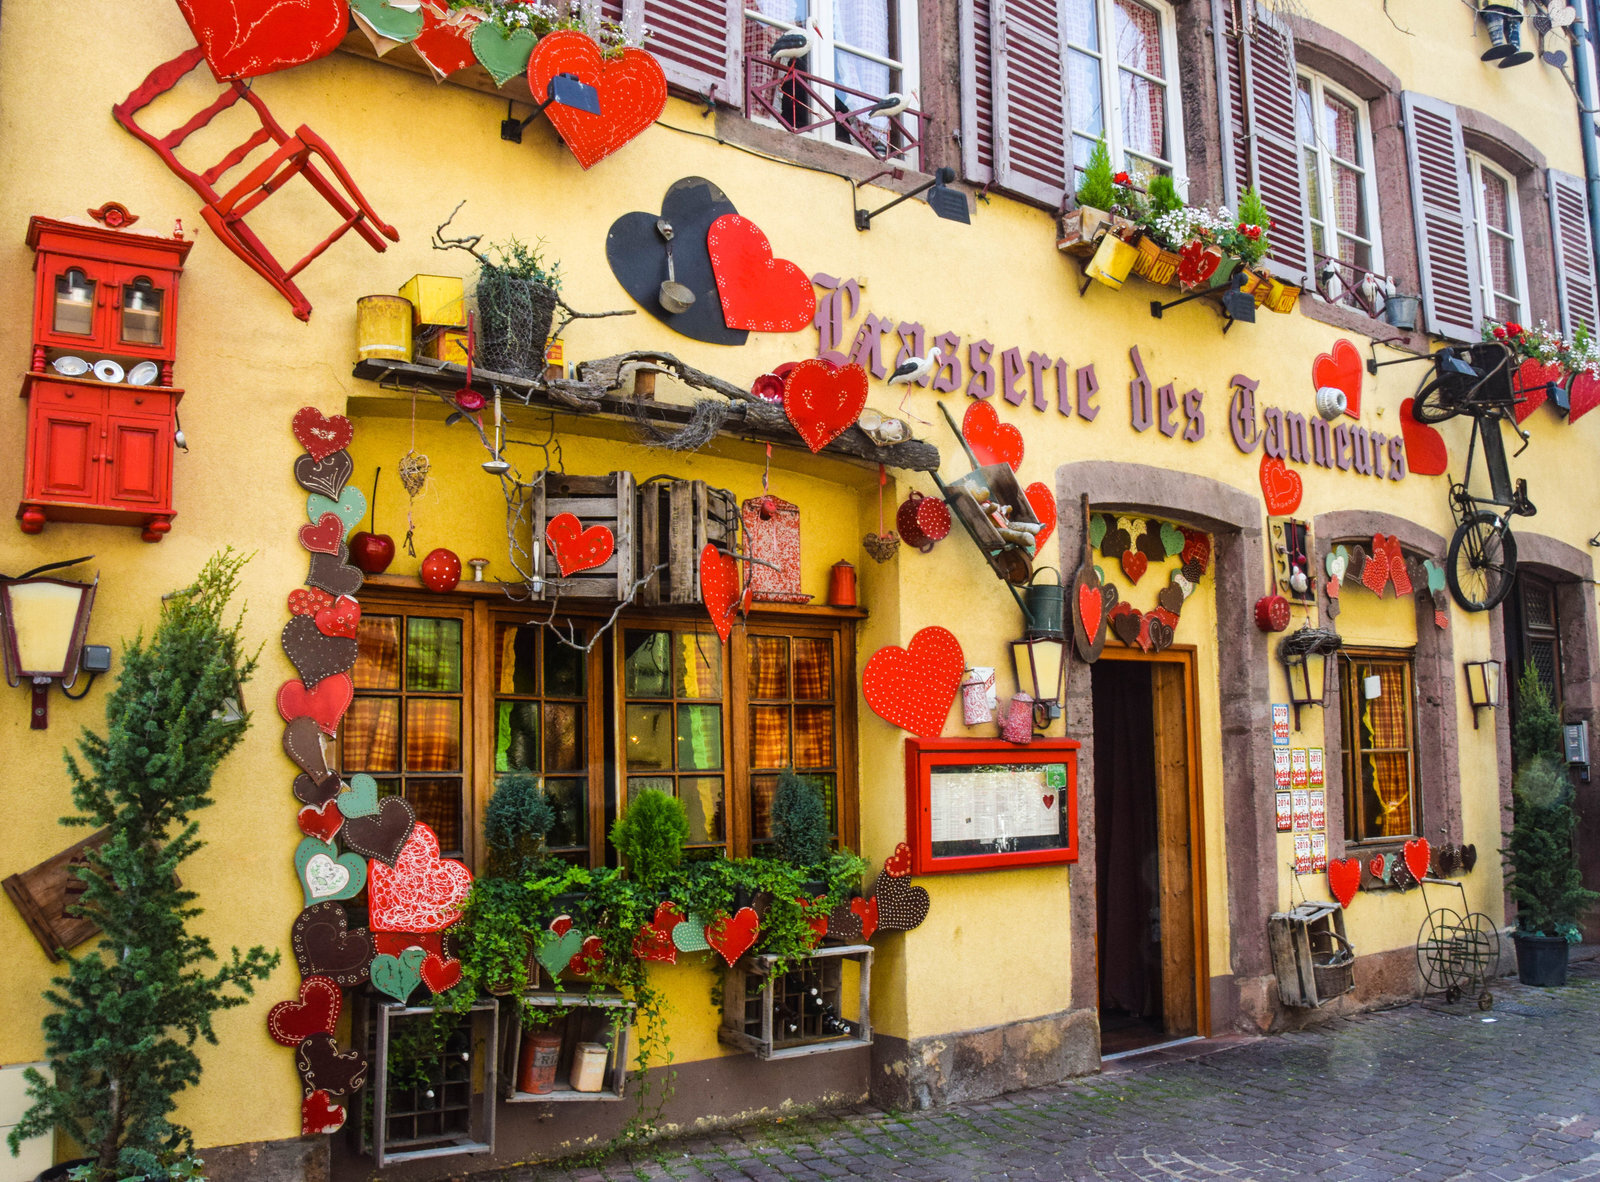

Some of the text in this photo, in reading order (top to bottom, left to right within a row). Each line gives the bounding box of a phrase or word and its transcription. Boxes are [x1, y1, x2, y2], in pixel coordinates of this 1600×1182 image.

[1133, 249, 1153, 276] UB
[1148, 260, 1176, 285] KUB
[811, 272, 1406, 482] Brasserie des Tanneurs
[1274, 707, 1287, 717] 2019
[1276, 755, 1288, 764] 2011
[1293, 755, 1305, 763] 2012
[1277, 799, 1290, 807] 2014
[1295, 798, 1307, 806] 2015
[1311, 798, 1324, 807] 2016
[1313, 840, 1324, 848] 2017
